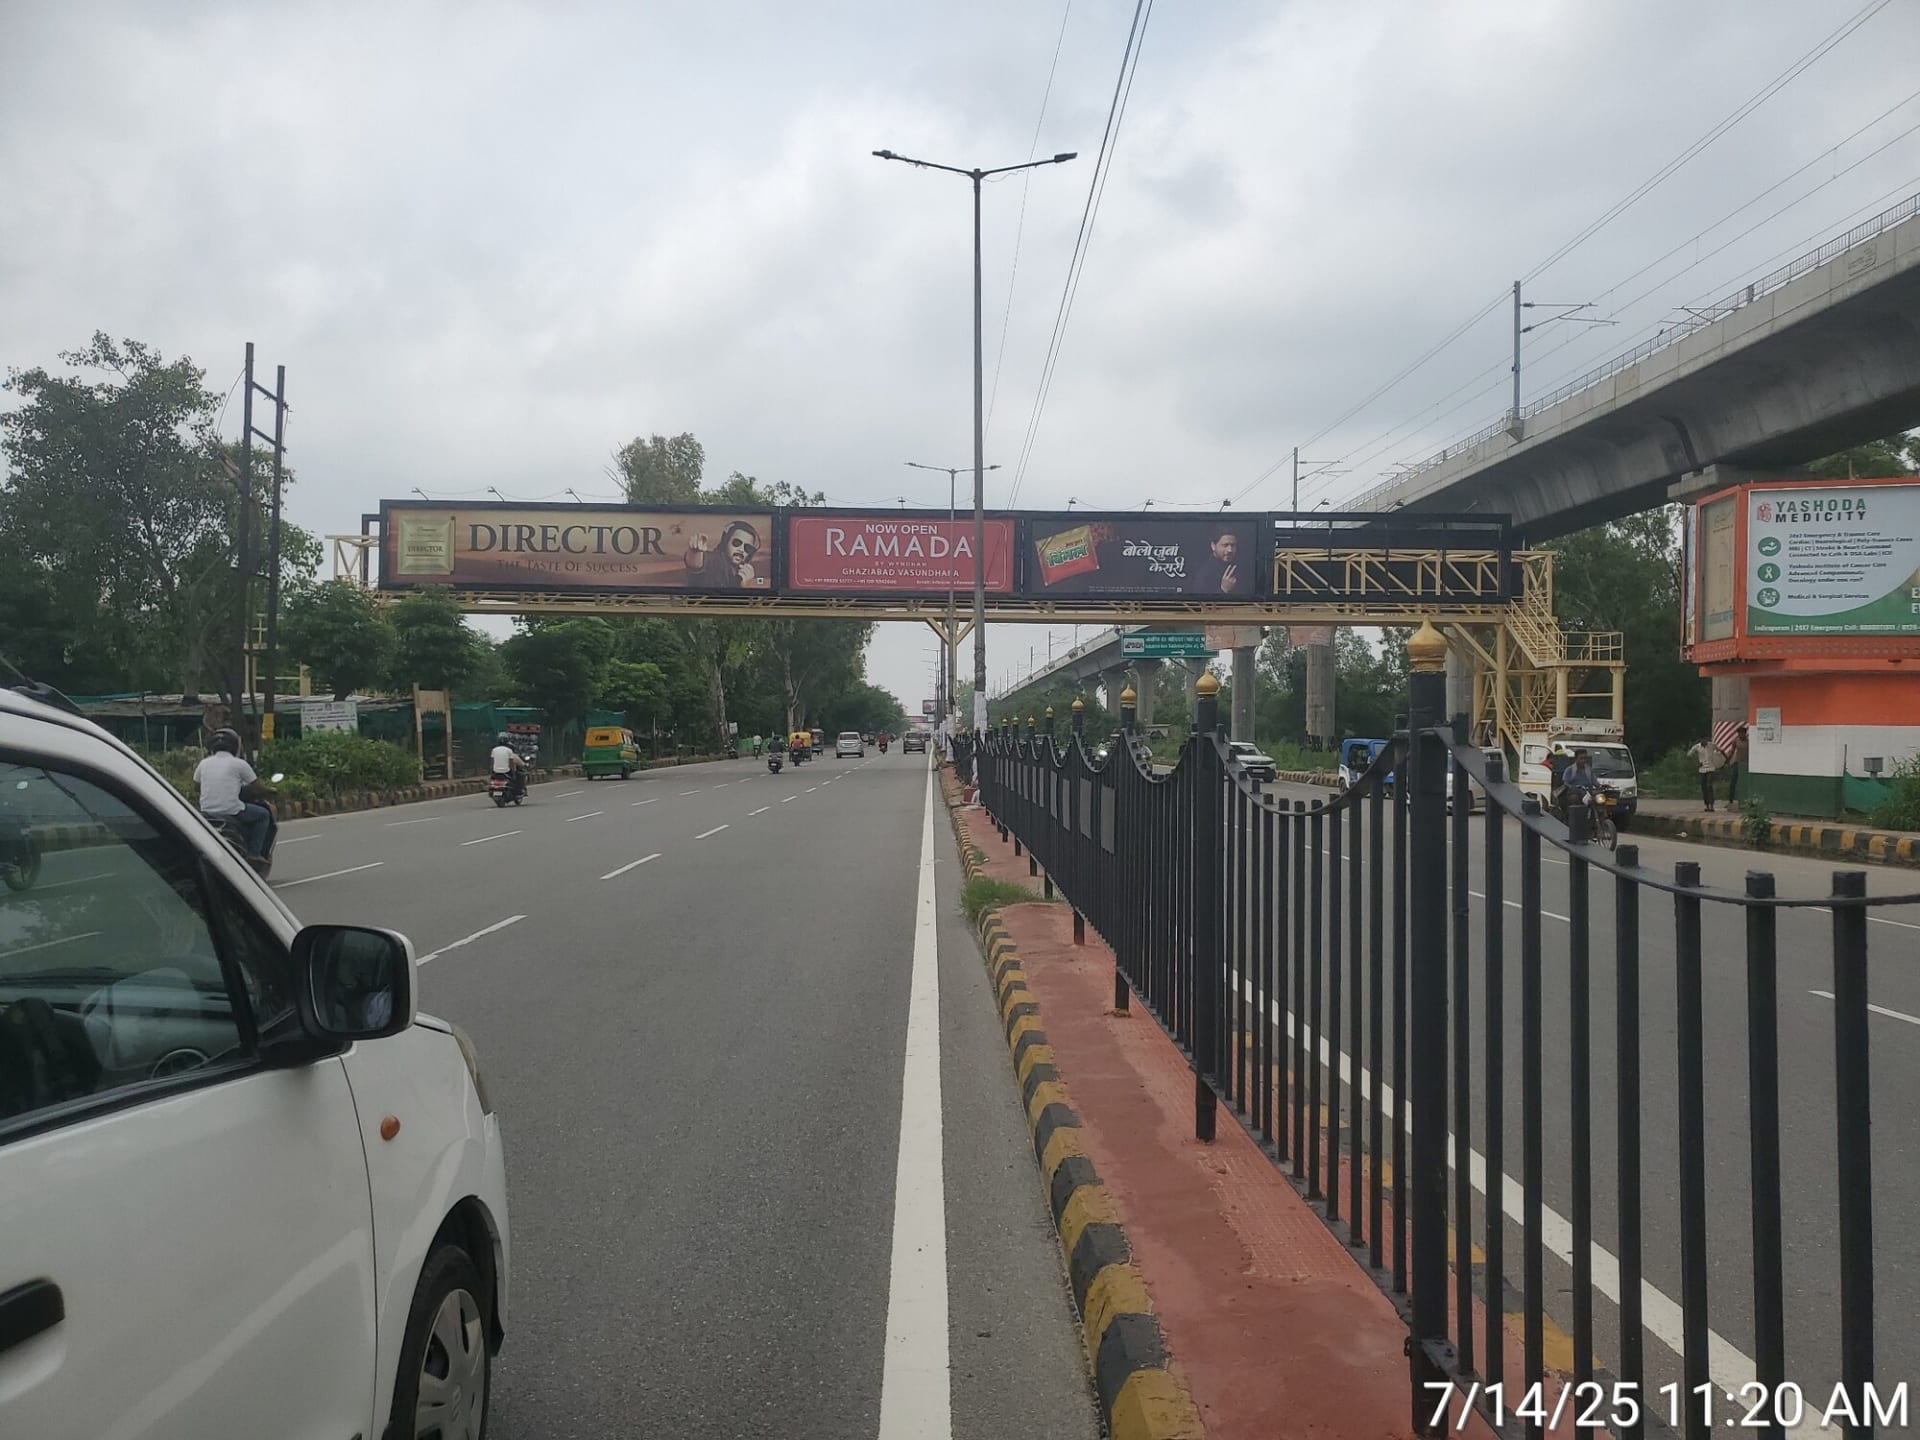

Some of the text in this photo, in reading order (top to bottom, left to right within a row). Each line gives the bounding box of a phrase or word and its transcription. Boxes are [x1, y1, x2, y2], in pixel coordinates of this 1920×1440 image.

[1776, 499, 1867, 512] YASHODA
[1776, 511, 1866, 523] MEDICITY
[865, 524, 938, 535] NOW OPEN
[468, 523, 666, 556] DIRECTOR
[825, 527, 973, 558] RAMADA
[1122, 540, 1152, 556] बोलो
[497, 559, 639, 573] THE TASTE OF SUCCESS
[842, 567, 896, 577] GHAZIABAD
[1148, 556, 1186, 577] केसरी
